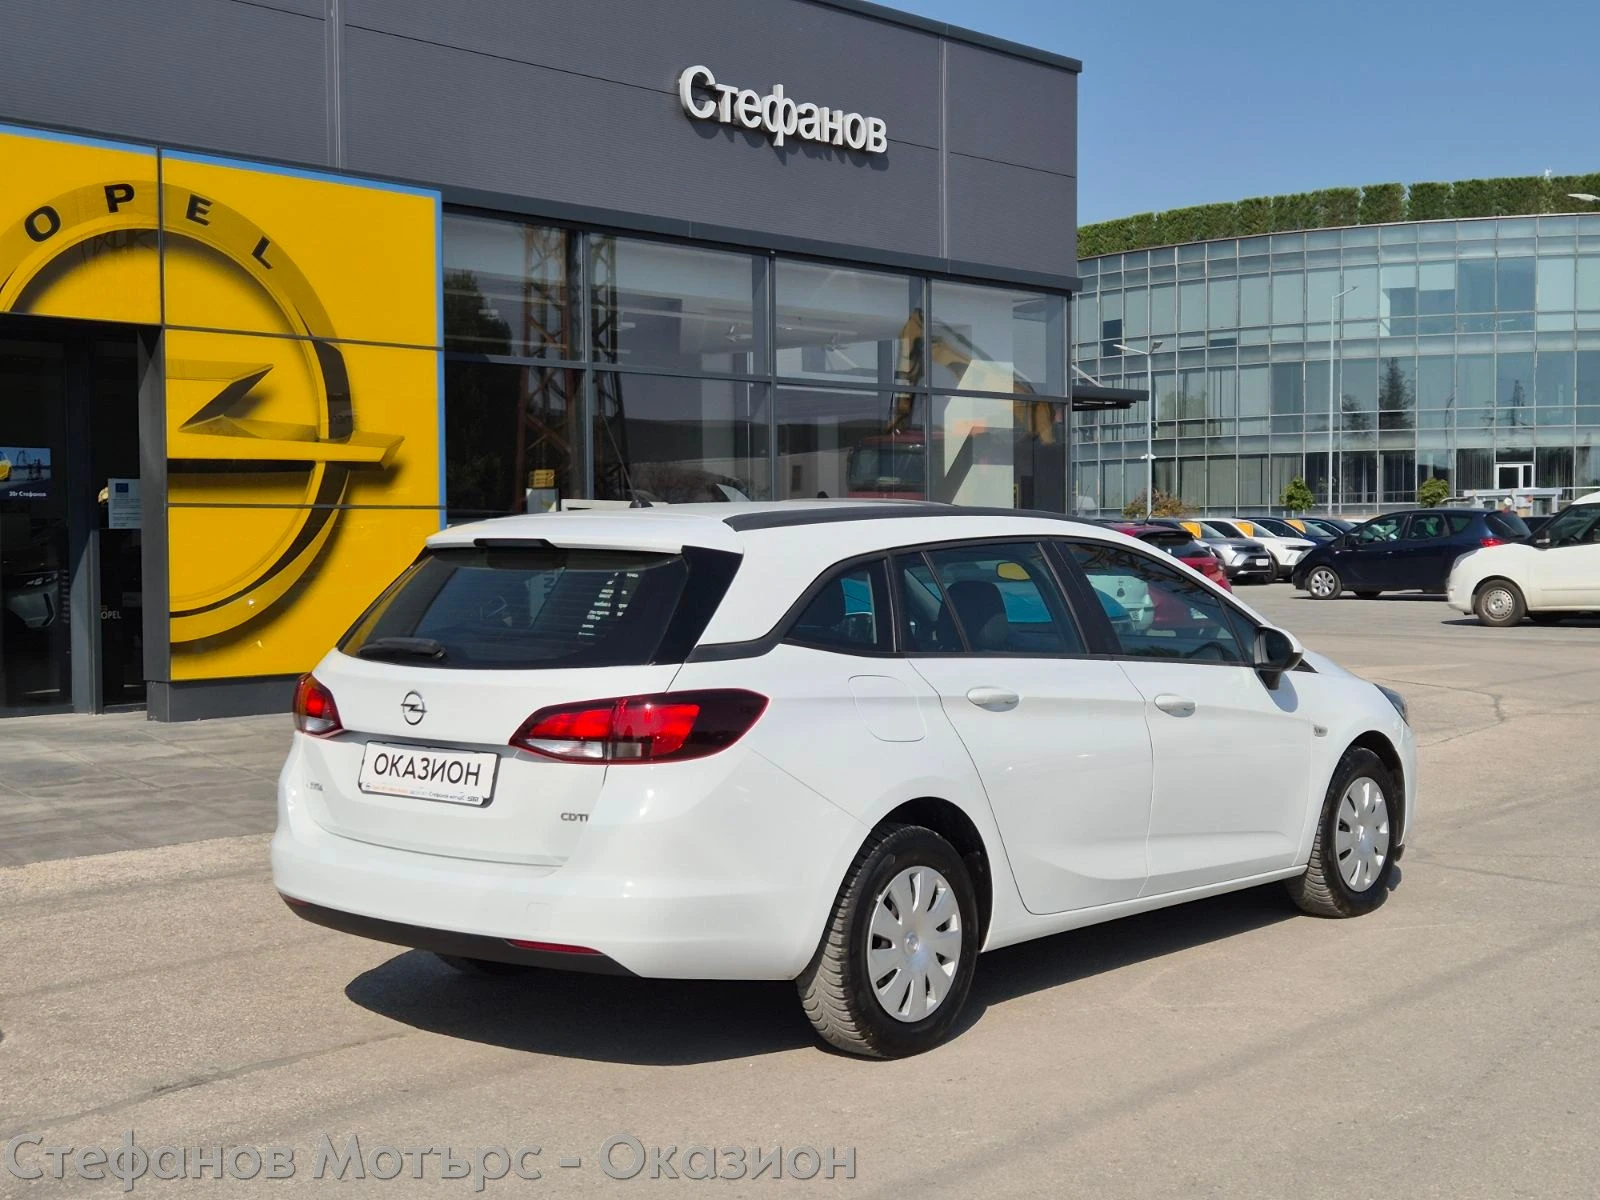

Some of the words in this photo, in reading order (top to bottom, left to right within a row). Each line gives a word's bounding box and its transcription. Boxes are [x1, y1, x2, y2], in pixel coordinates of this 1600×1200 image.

[679, 65, 888, 153] Стефанов
[24, 183, 274, 270] OPEL
[374, 753, 481, 786] ОКАЗИОН
